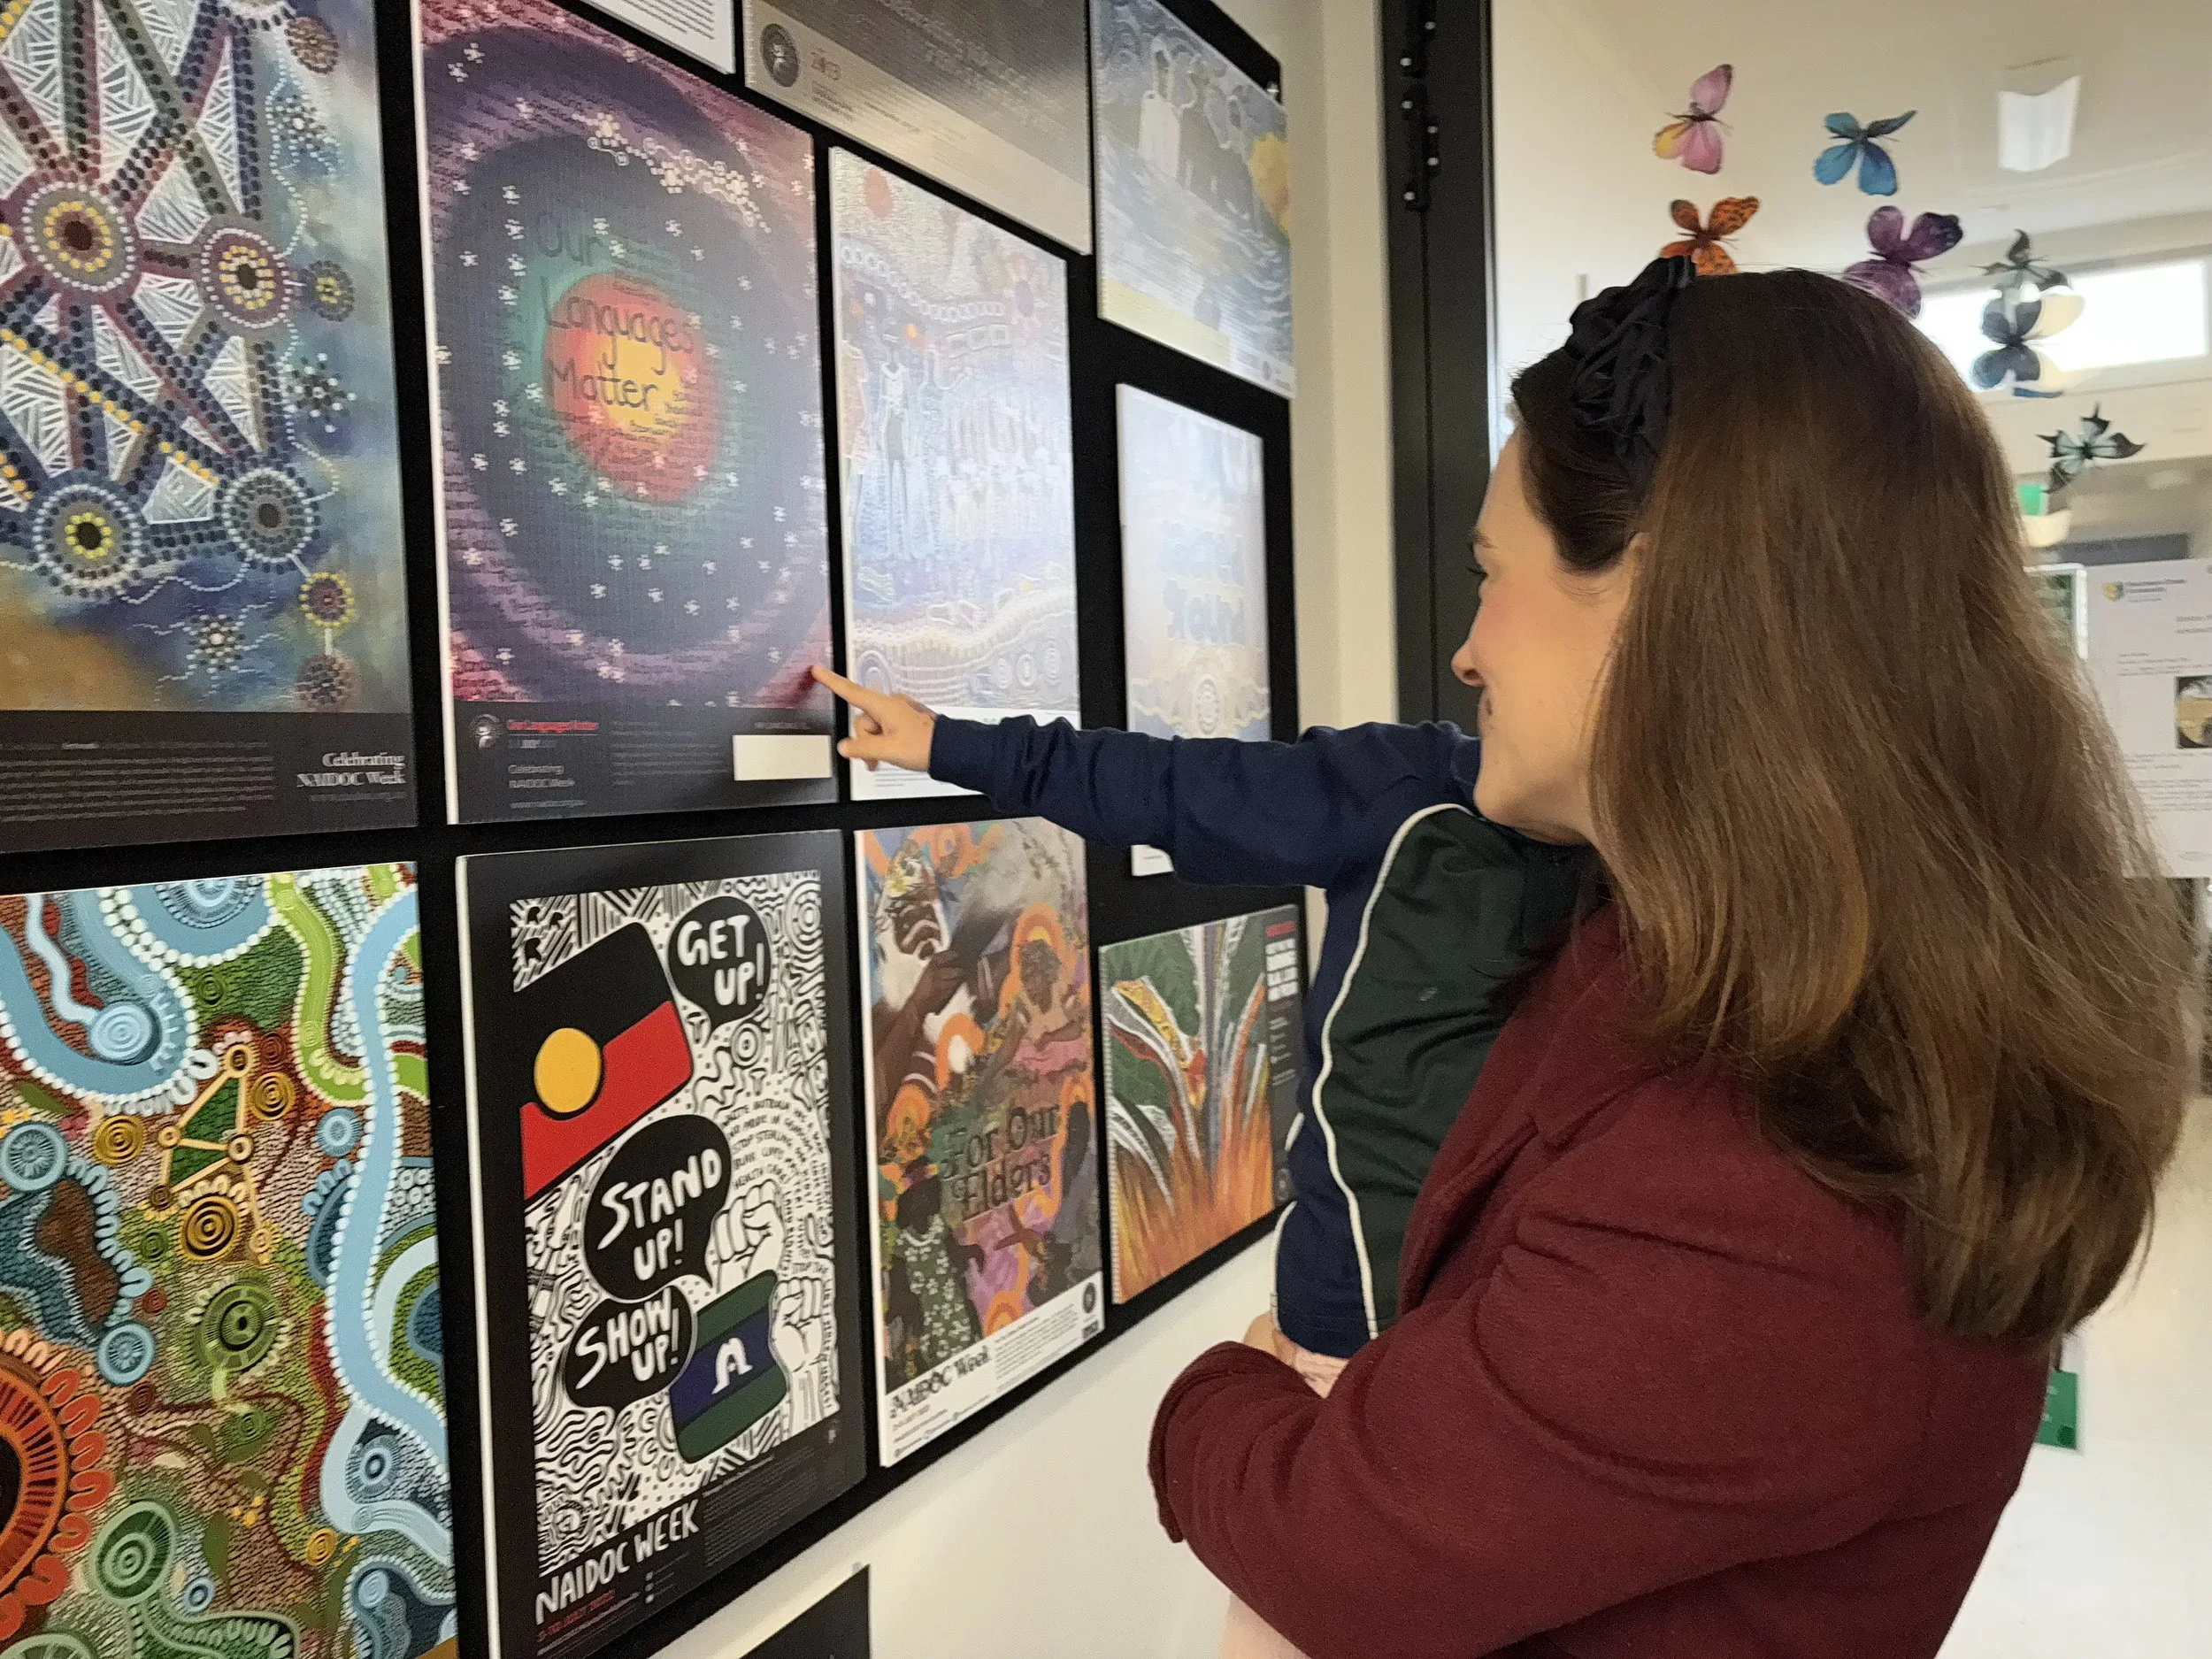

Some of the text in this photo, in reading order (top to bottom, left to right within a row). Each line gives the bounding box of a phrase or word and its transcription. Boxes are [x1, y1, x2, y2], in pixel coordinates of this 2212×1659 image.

[541, 212, 604, 267] Our
[539, 274, 696, 376] Languages
[543, 357, 658, 412] Matter
[296, 770, 407, 787] NAIDOC Week
[322, 751, 407, 770] Celebrating
[677, 914, 751, 966] GET
[714, 942, 765, 1006] UP!
[938, 1104, 1061, 1181] For Our
[597, 1148, 722, 1250] STAND
[952, 1152, 1053, 1222] Elders
[633, 1217, 684, 1281] UP!
[575, 1286, 672, 1390] SHOW
[630, 1308, 680, 1382] UP!
[535, 1541, 631, 1625] NAIDOC
[634, 1498, 700, 1563] WEEK
